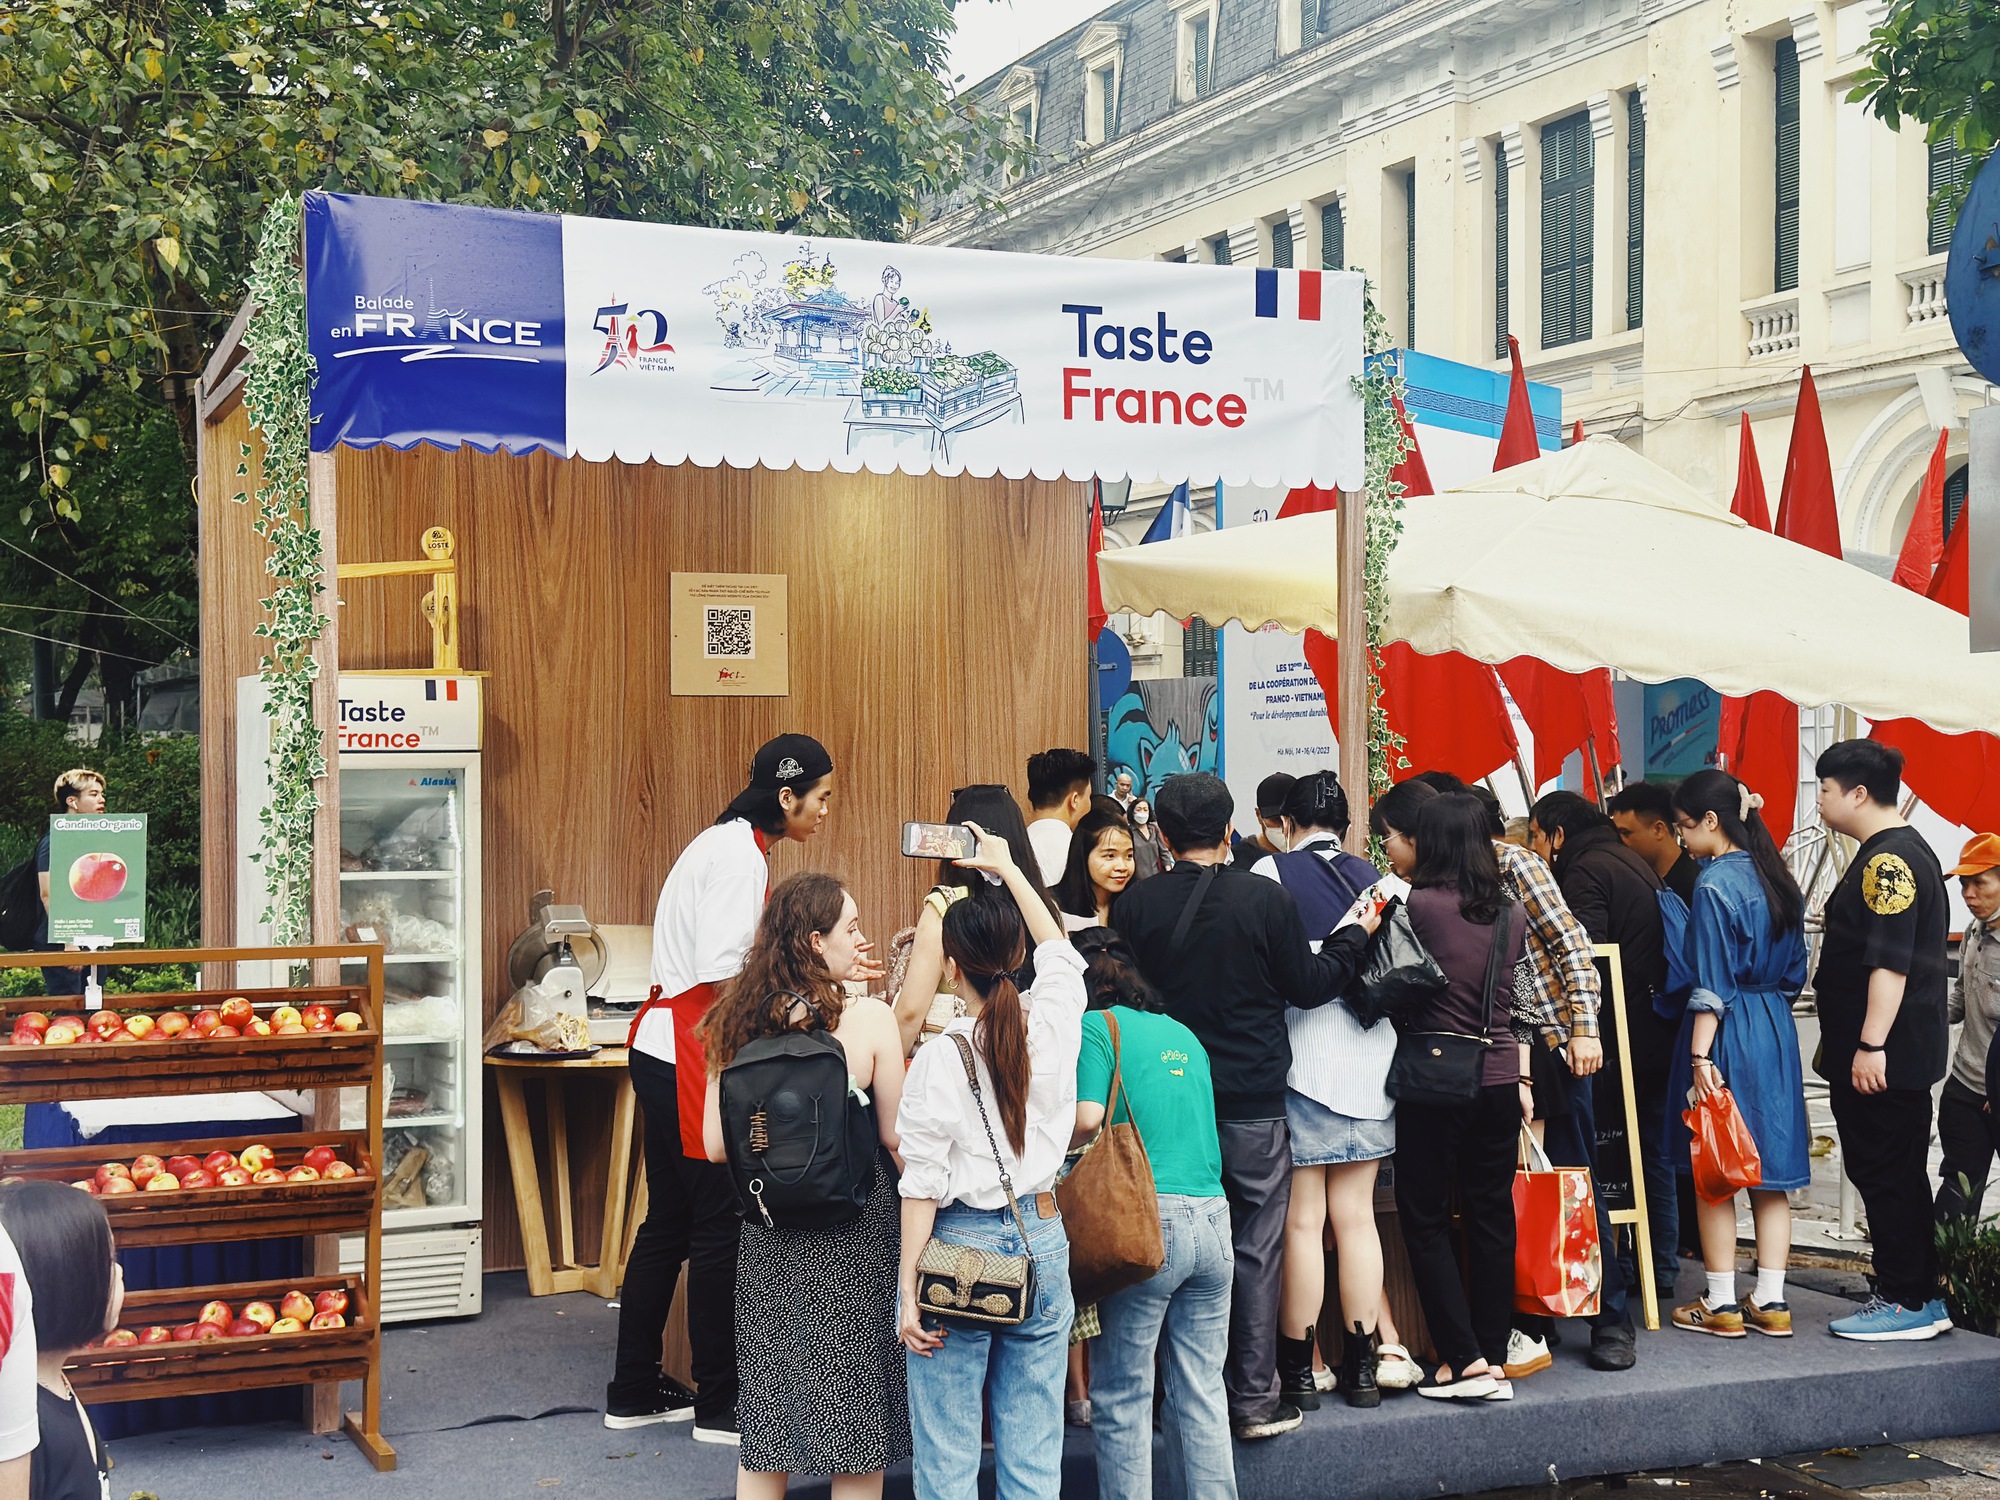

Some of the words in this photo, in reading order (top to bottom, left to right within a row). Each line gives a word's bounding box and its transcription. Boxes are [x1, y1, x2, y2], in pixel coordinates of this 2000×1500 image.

[355, 295, 414, 310] Balade
[331, 326, 351, 338] en
[355, 308, 542, 346] FRANCE
[1062, 304, 1213, 364] Taste
[639, 356, 668, 365] FRANCE
[1063, 368, 1247, 428] France
[1276, 663, 1287, 672] LES
[1249, 681, 1256, 690] DE
[1257, 681, 1265, 690] LA
[1266, 677, 1309, 689] COOPÉRATION
[1265, 694, 1290, 704] FRANCO
[1294, 692, 1326, 702] VIETNAMI
[338, 699, 406, 722] Taste
[1266, 710, 1271, 719] le
[1271, 709, 1308, 721] développement
[420, 777, 457, 786] Alaska
